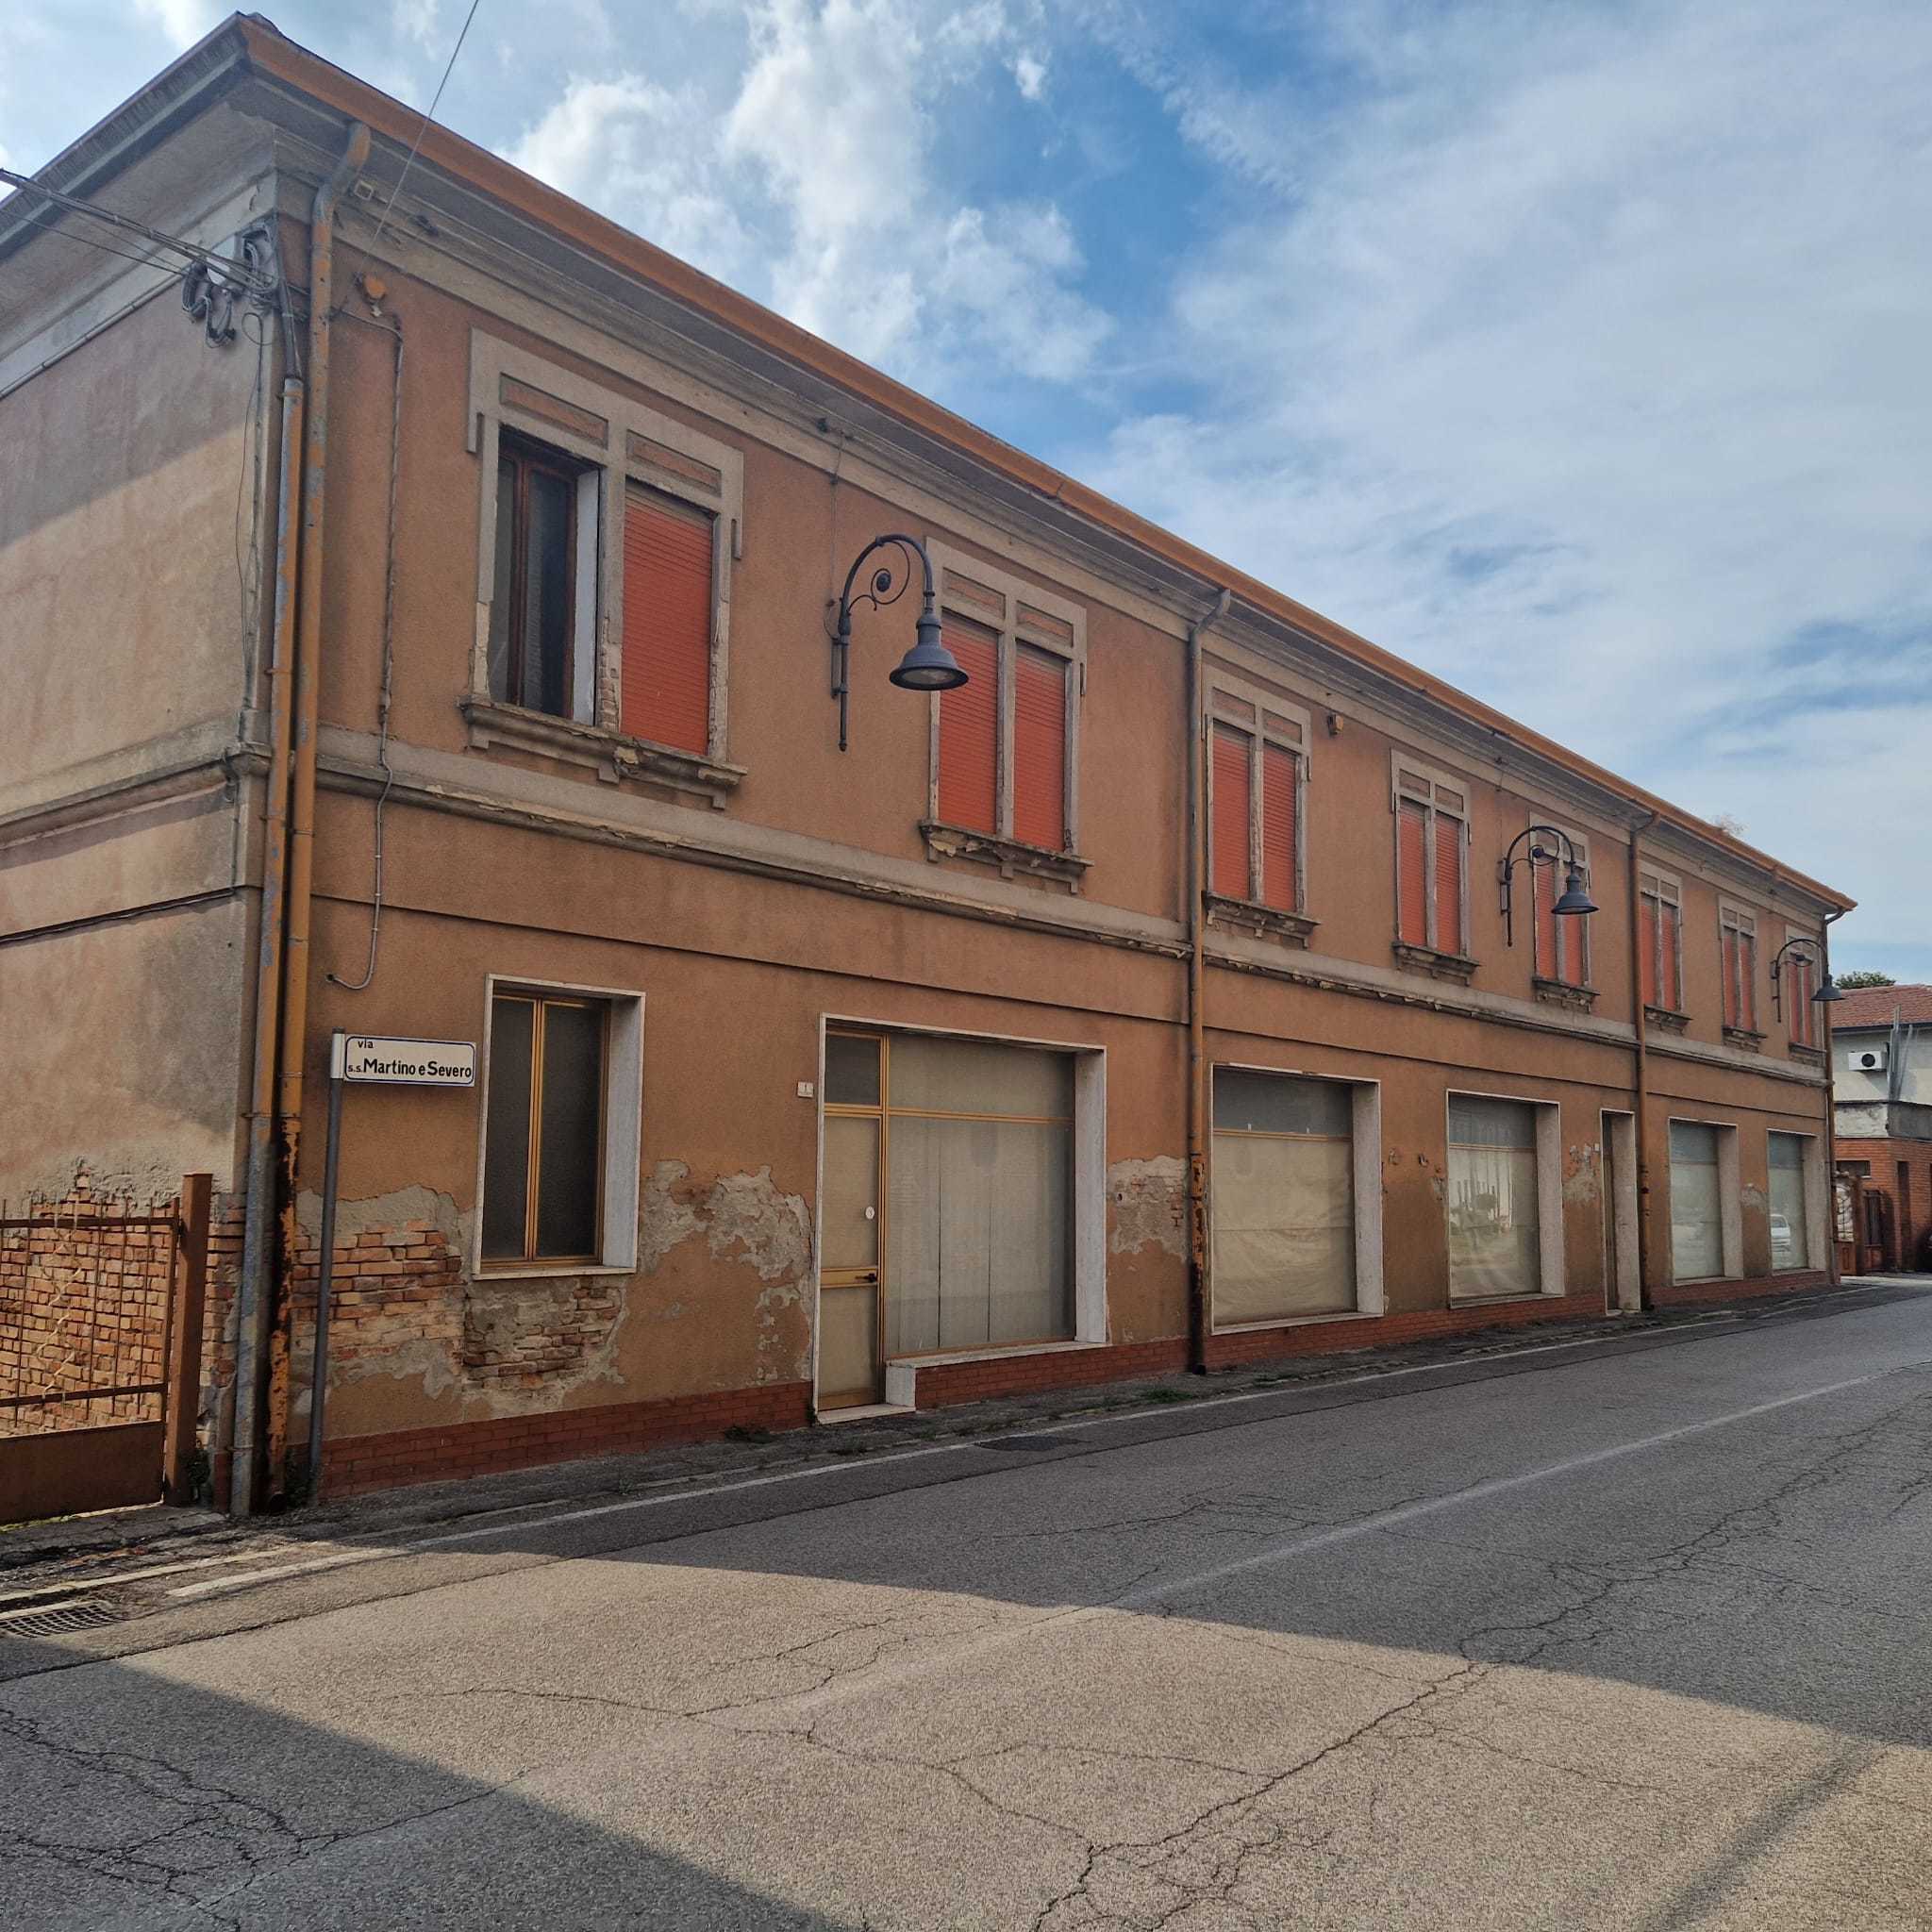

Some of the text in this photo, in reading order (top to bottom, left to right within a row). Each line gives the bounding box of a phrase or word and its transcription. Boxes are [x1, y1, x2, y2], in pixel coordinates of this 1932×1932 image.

[358, 1039, 374, 1048] via
[363, 1058, 416, 1075] Martino
[418, 1065, 425, 1075] e
[427, 1060, 472, 1077] Severo
